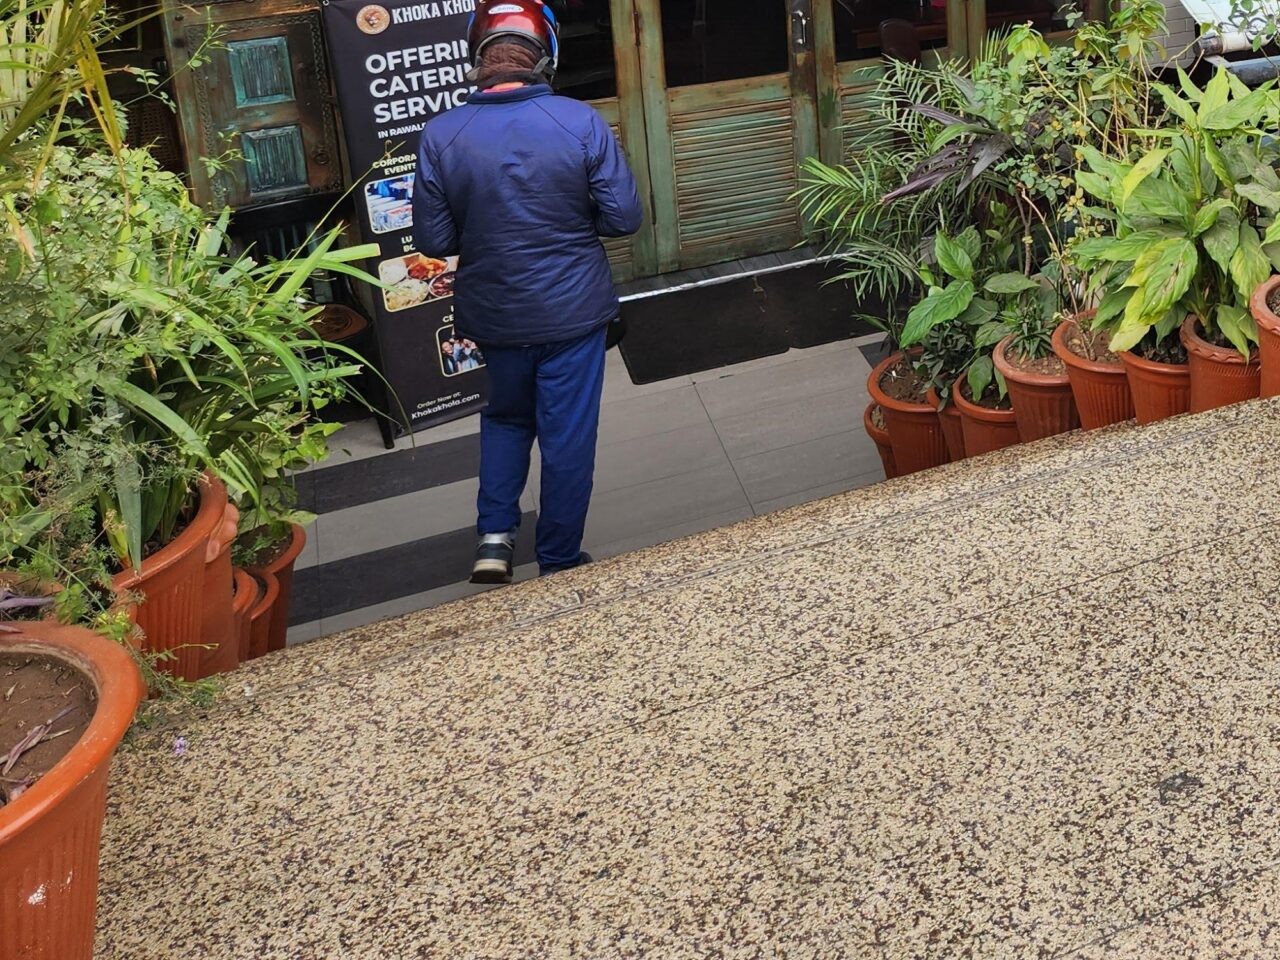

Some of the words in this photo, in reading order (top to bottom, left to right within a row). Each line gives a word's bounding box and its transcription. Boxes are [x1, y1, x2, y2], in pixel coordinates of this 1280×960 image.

[391, 2, 442, 25] KHOKA
[365, 39, 469, 74] OFFERIN
[369, 62, 473, 99] CATERI
[373, 86, 478, 124] SERVIC
[377, 129, 389, 139] IN
[372, 153, 417, 169] CORPORA
[410, 393, 480, 420] Khokakhola.com
[416, 399, 437, 409] Order
[437, 394, 452, 403] Now
